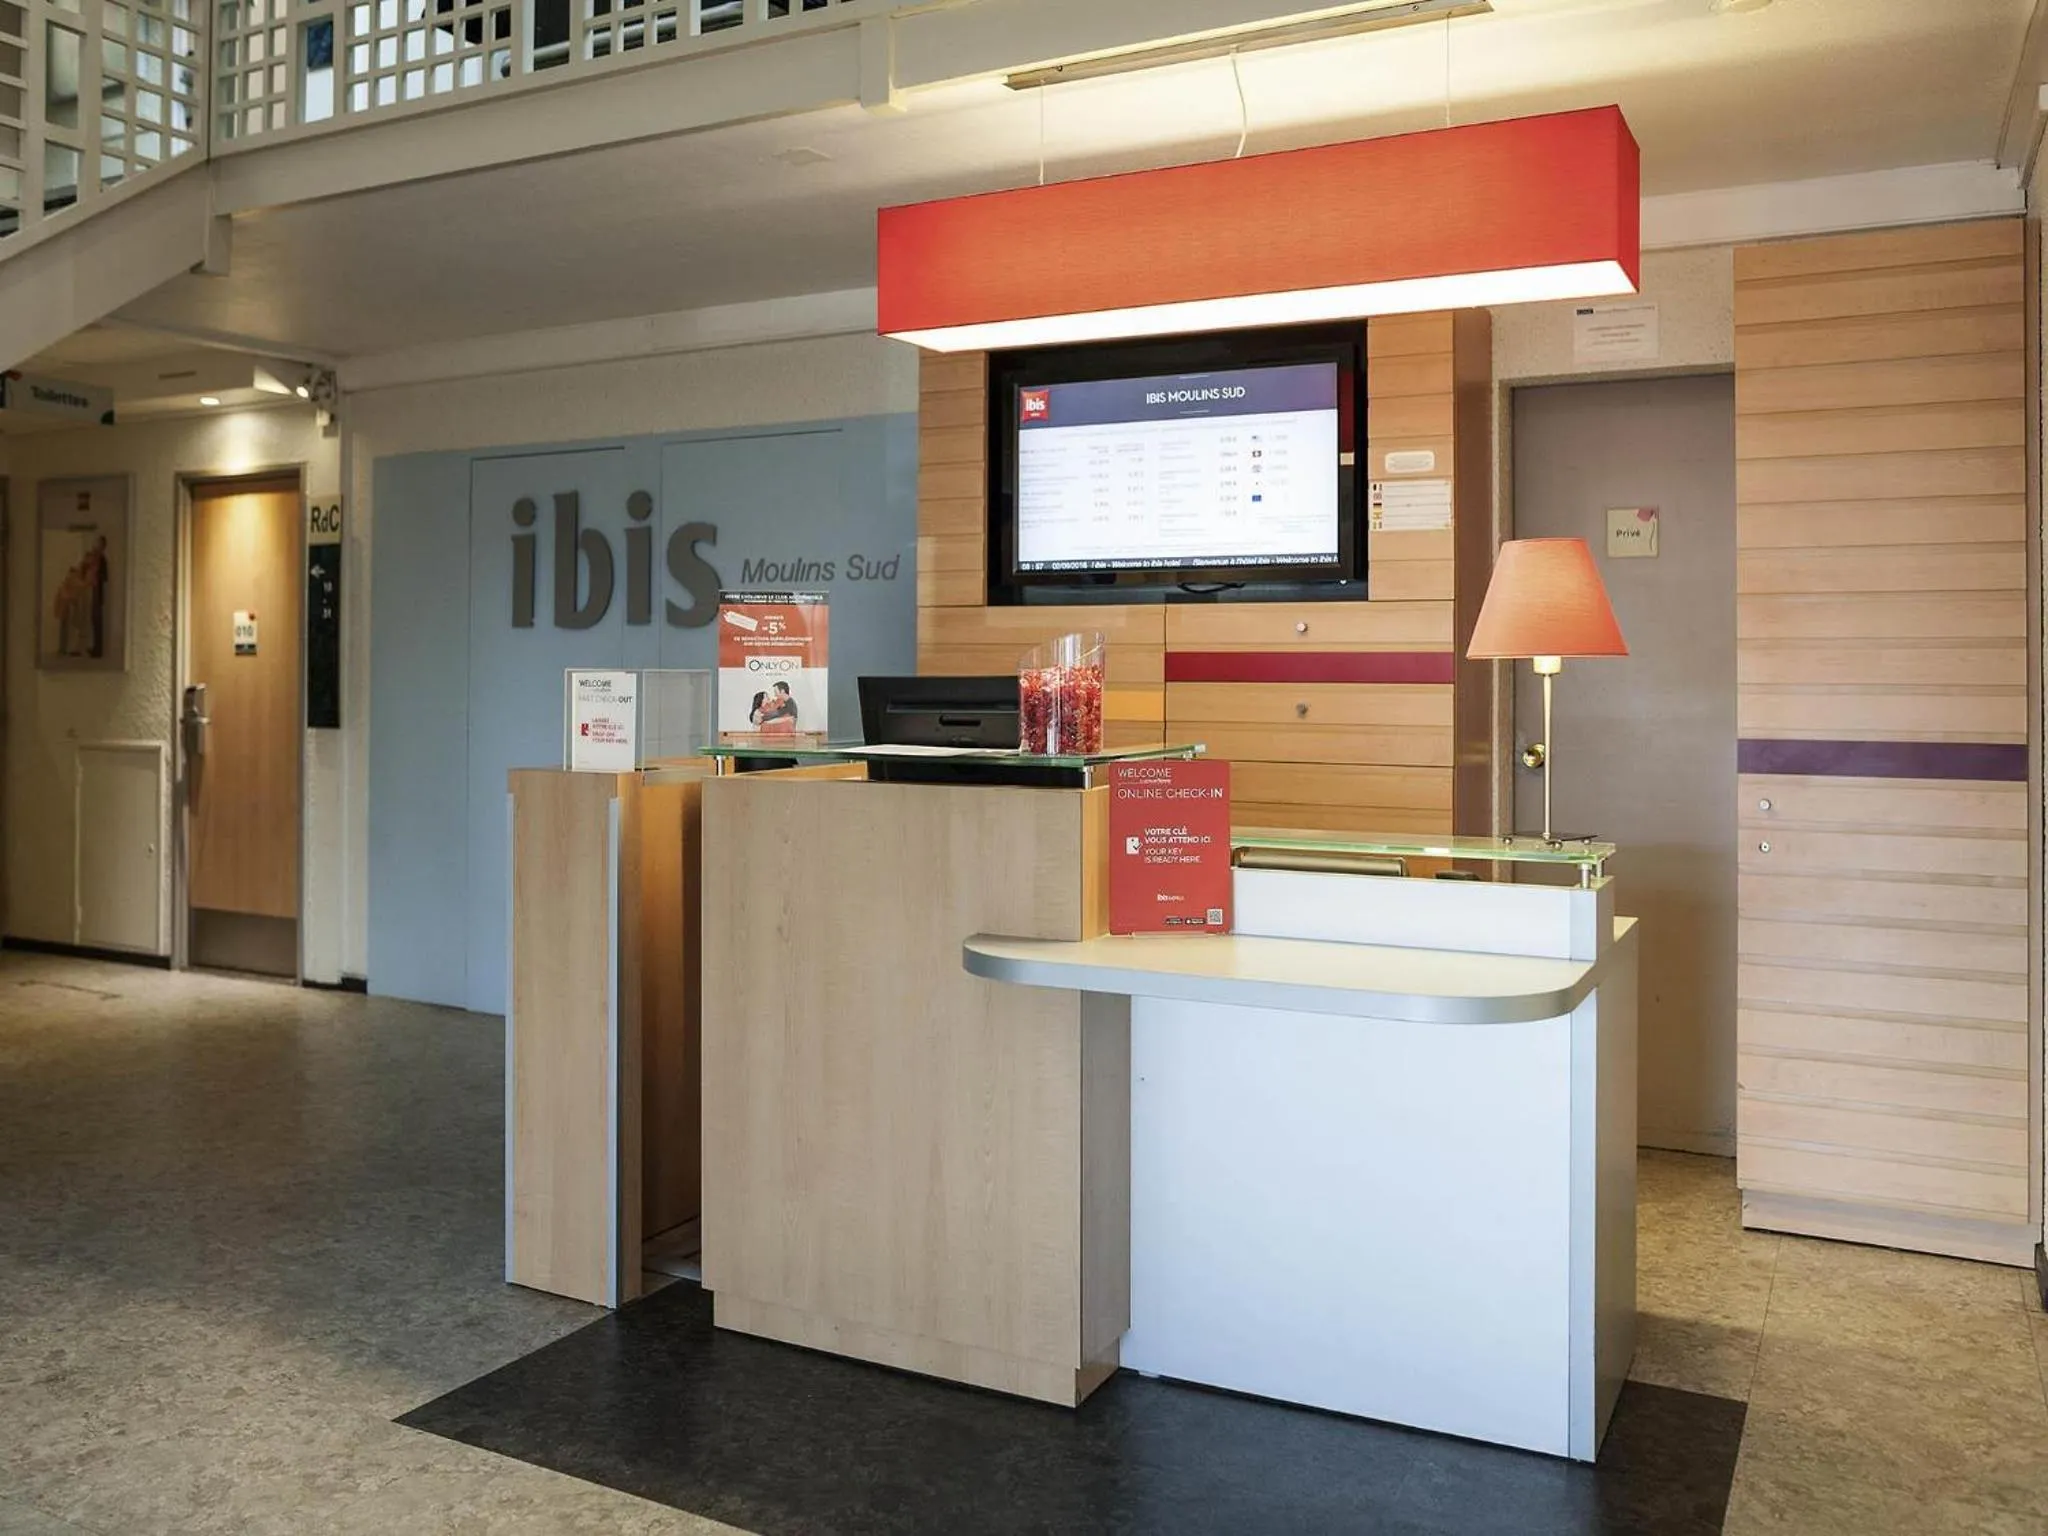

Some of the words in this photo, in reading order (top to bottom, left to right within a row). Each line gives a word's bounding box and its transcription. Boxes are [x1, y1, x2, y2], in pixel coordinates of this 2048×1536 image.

[1146, 391, 1166, 404] IBIS
[1168, 388, 1219, 402] MOULINS
[1222, 386, 1245, 399] SUD
[1026, 398, 1046, 411] ibis
[311, 504, 339, 532] RdC
[511, 490, 722, 630] ibis
[741, 558, 835, 583] Moulins
[846, 554, 900, 581] Sud
[762, 621, 786, 634] -5%
[579, 679, 612, 687] WELCOME
[1118, 768, 1171, 778] WELCOME
[1118, 789, 1162, 799] ONLINE
[1166, 788, 1223, 799] CHECK-IN
[1144, 847, 1167, 855] YOUR
[1168, 847, 1183, 855] KEY
